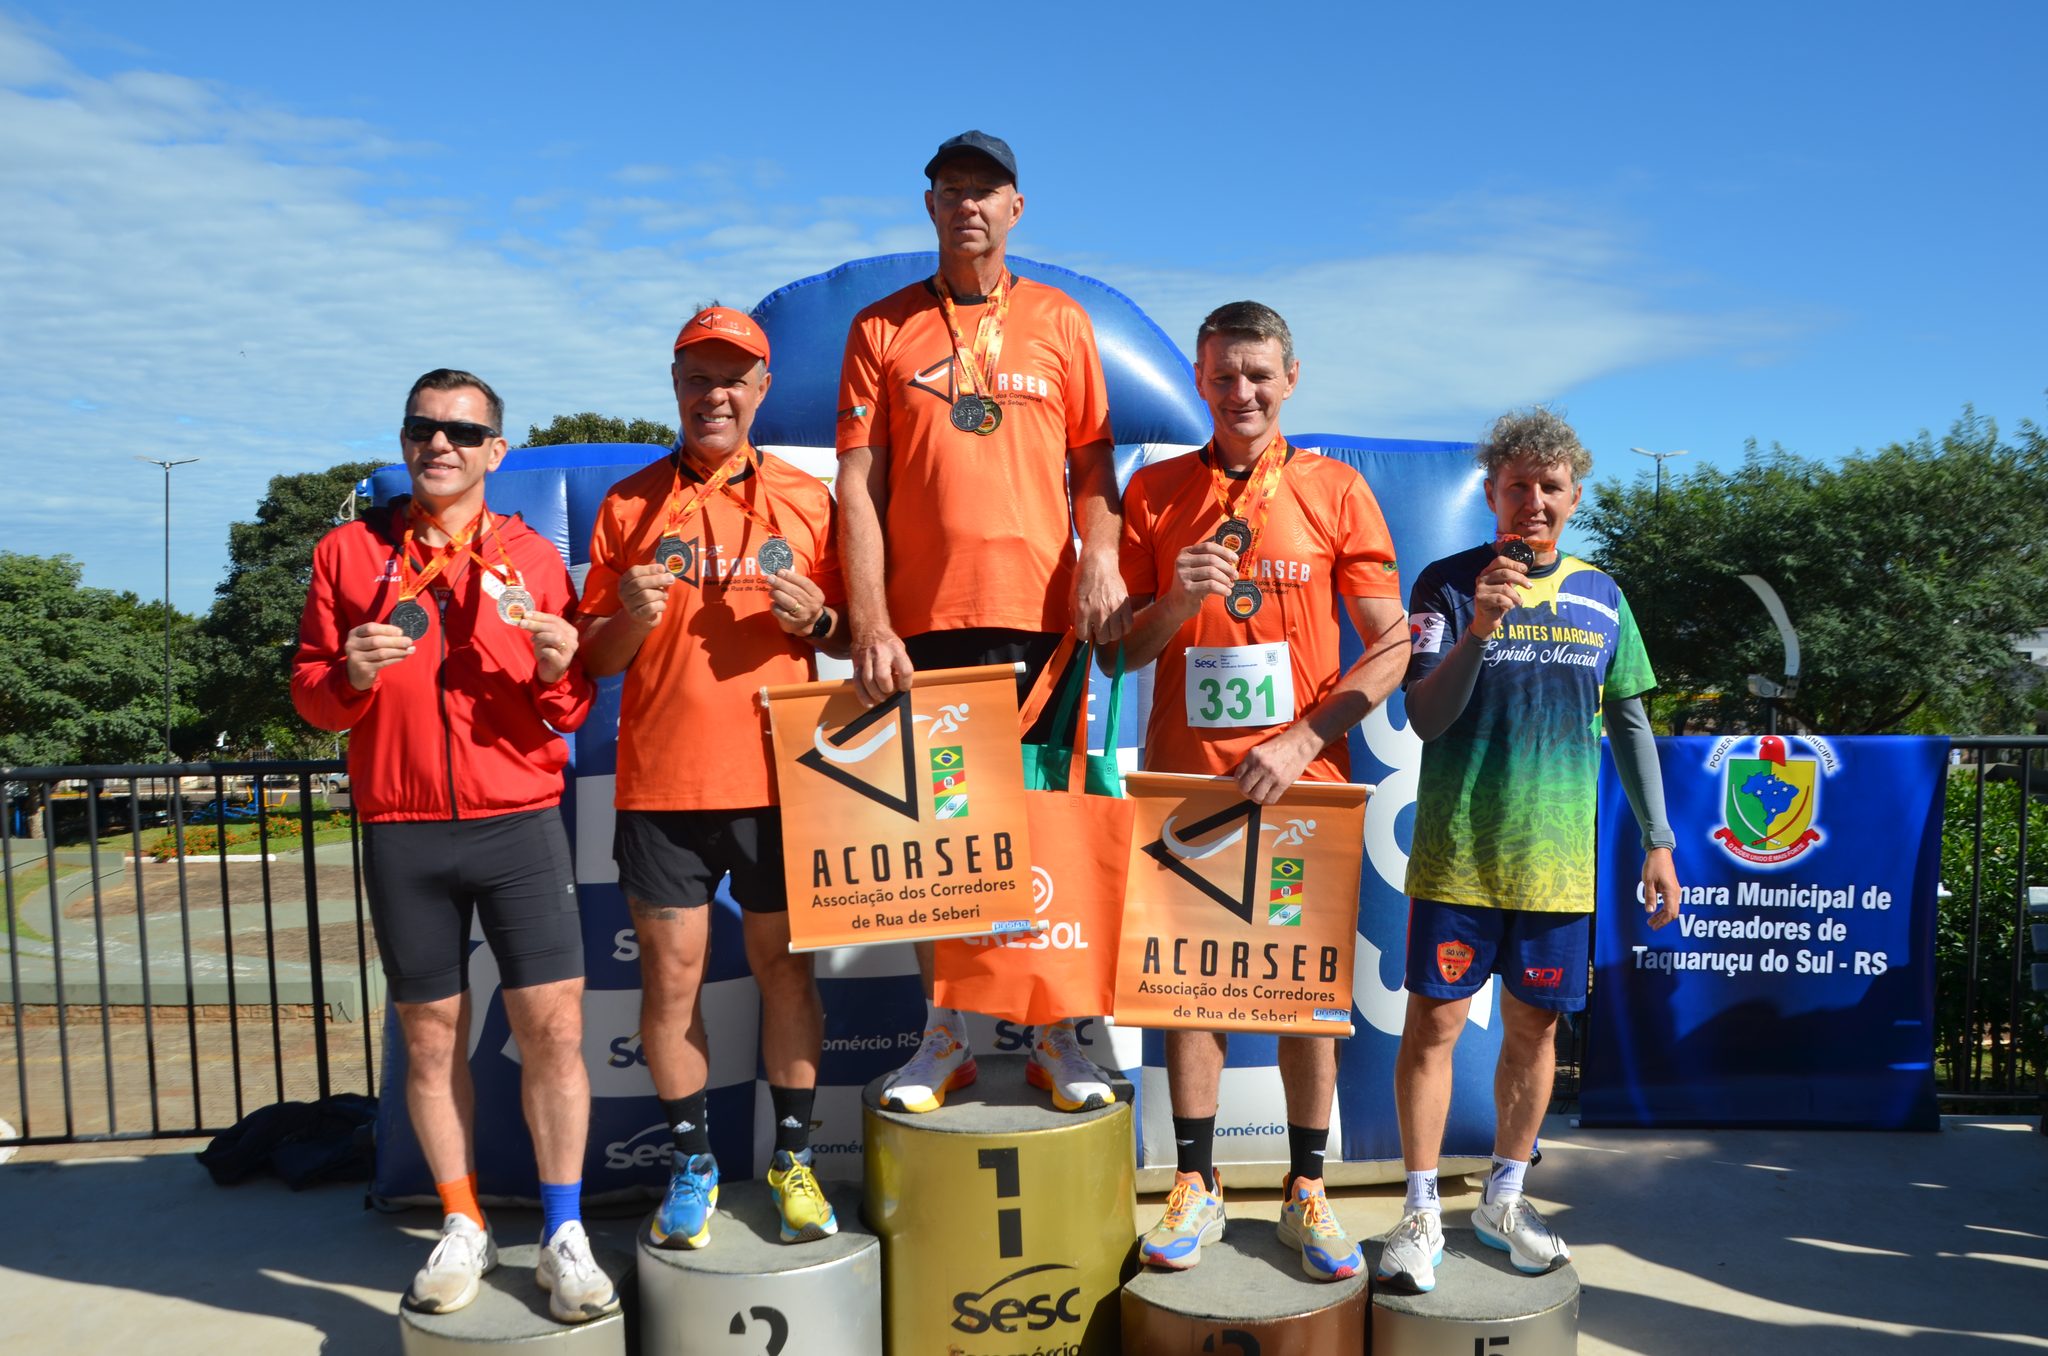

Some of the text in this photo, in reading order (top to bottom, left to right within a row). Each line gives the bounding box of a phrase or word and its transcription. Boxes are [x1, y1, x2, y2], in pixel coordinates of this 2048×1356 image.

[997, 373, 1048, 398] RSEB
[701, 557, 768, 577] ACOR
[1253, 560, 1310, 582] RSEB
[1509, 624, 1548, 641] ARTES
[1551, 626, 1605, 649] MARCIAIS
[1195, 658, 1217, 669] Sesc
[1480, 638, 1600, 668] Espírito Marcial
[1198, 674, 1276, 721] 331
[1709, 735, 1836, 771] PODER UNICIPAL
[813, 832, 1014, 888] ACORSEB
[811, 877, 1016, 908] Associação dos Corredores
[1737, 882, 1855, 914] Municipal
[1862, 886, 1892, 910] de
[851, 904, 981, 929] de Rua de Seberi
[1678, 914, 1847, 942] Vereadores de
[1142, 936, 1338, 983] ACORSEB
[1632, 946, 1754, 977] Taquaruçu
[1759, 948, 1789, 973] do
[1795, 950, 1834, 974] Sul
[1854, 951, 1888, 976] RS
[1138, 980, 1335, 1003] Associação dos Corredores
[1173, 1005, 1297, 1023] de Rua de Seberi
[822, 1031, 920, 1051] omércio RS
[1213, 1122, 1285, 1137] omércio
[605, 1142, 675, 1169] Ses
[978, 1147, 1023, 1259] 1
[951, 1286, 1081, 1334] Sesc
